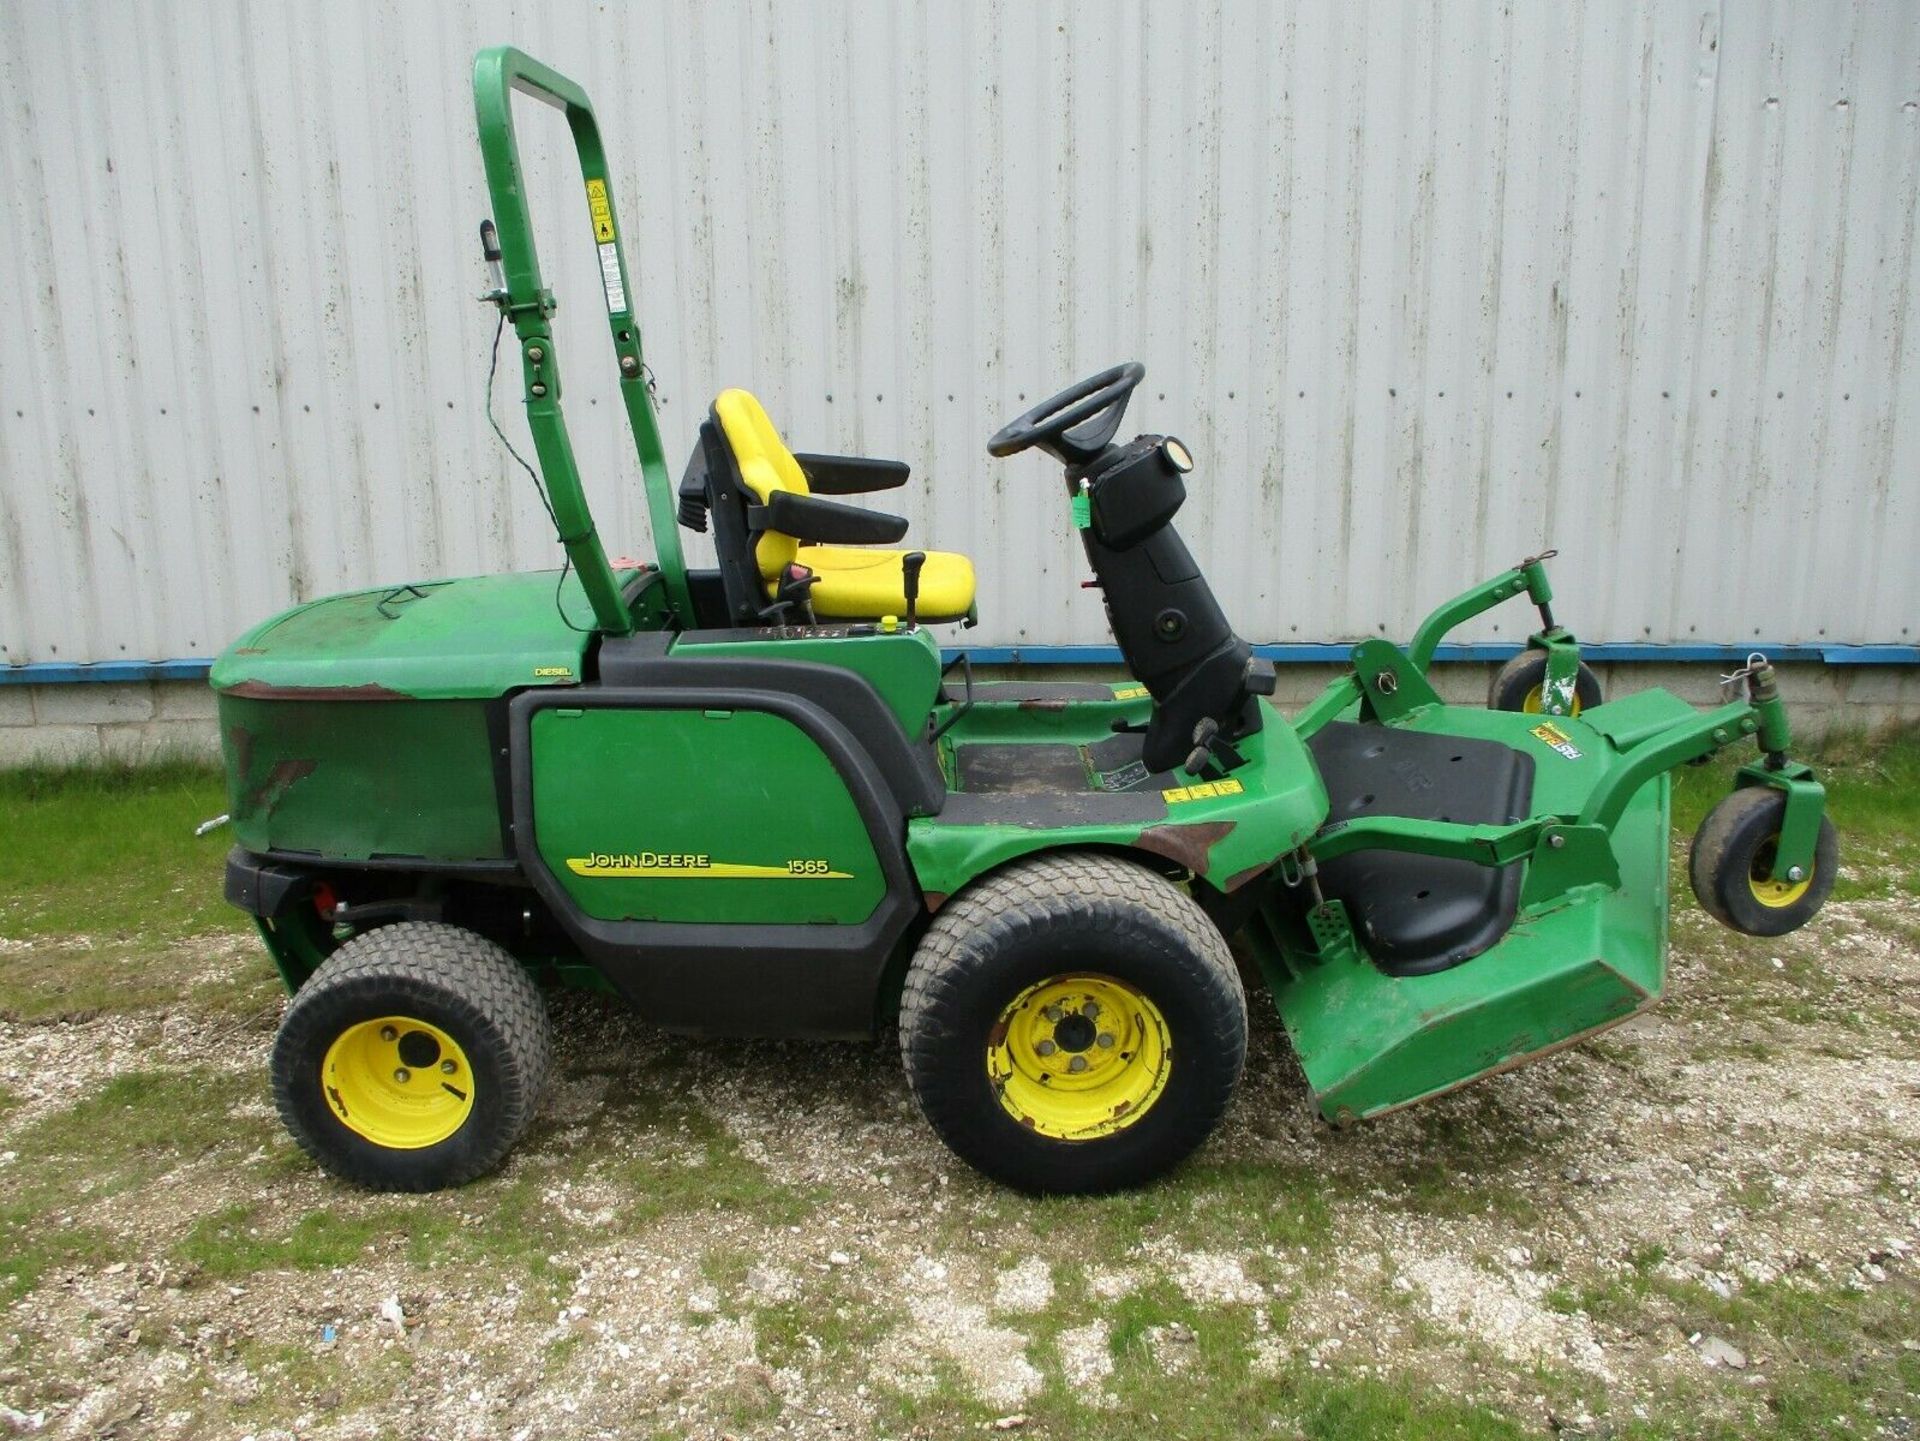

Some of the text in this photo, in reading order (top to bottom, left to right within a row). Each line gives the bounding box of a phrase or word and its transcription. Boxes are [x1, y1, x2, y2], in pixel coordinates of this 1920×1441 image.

[534, 667, 573, 677] DIESEL
[585, 852, 710, 868] JOHN DEERE
[787, 859, 829, 873] 1565
